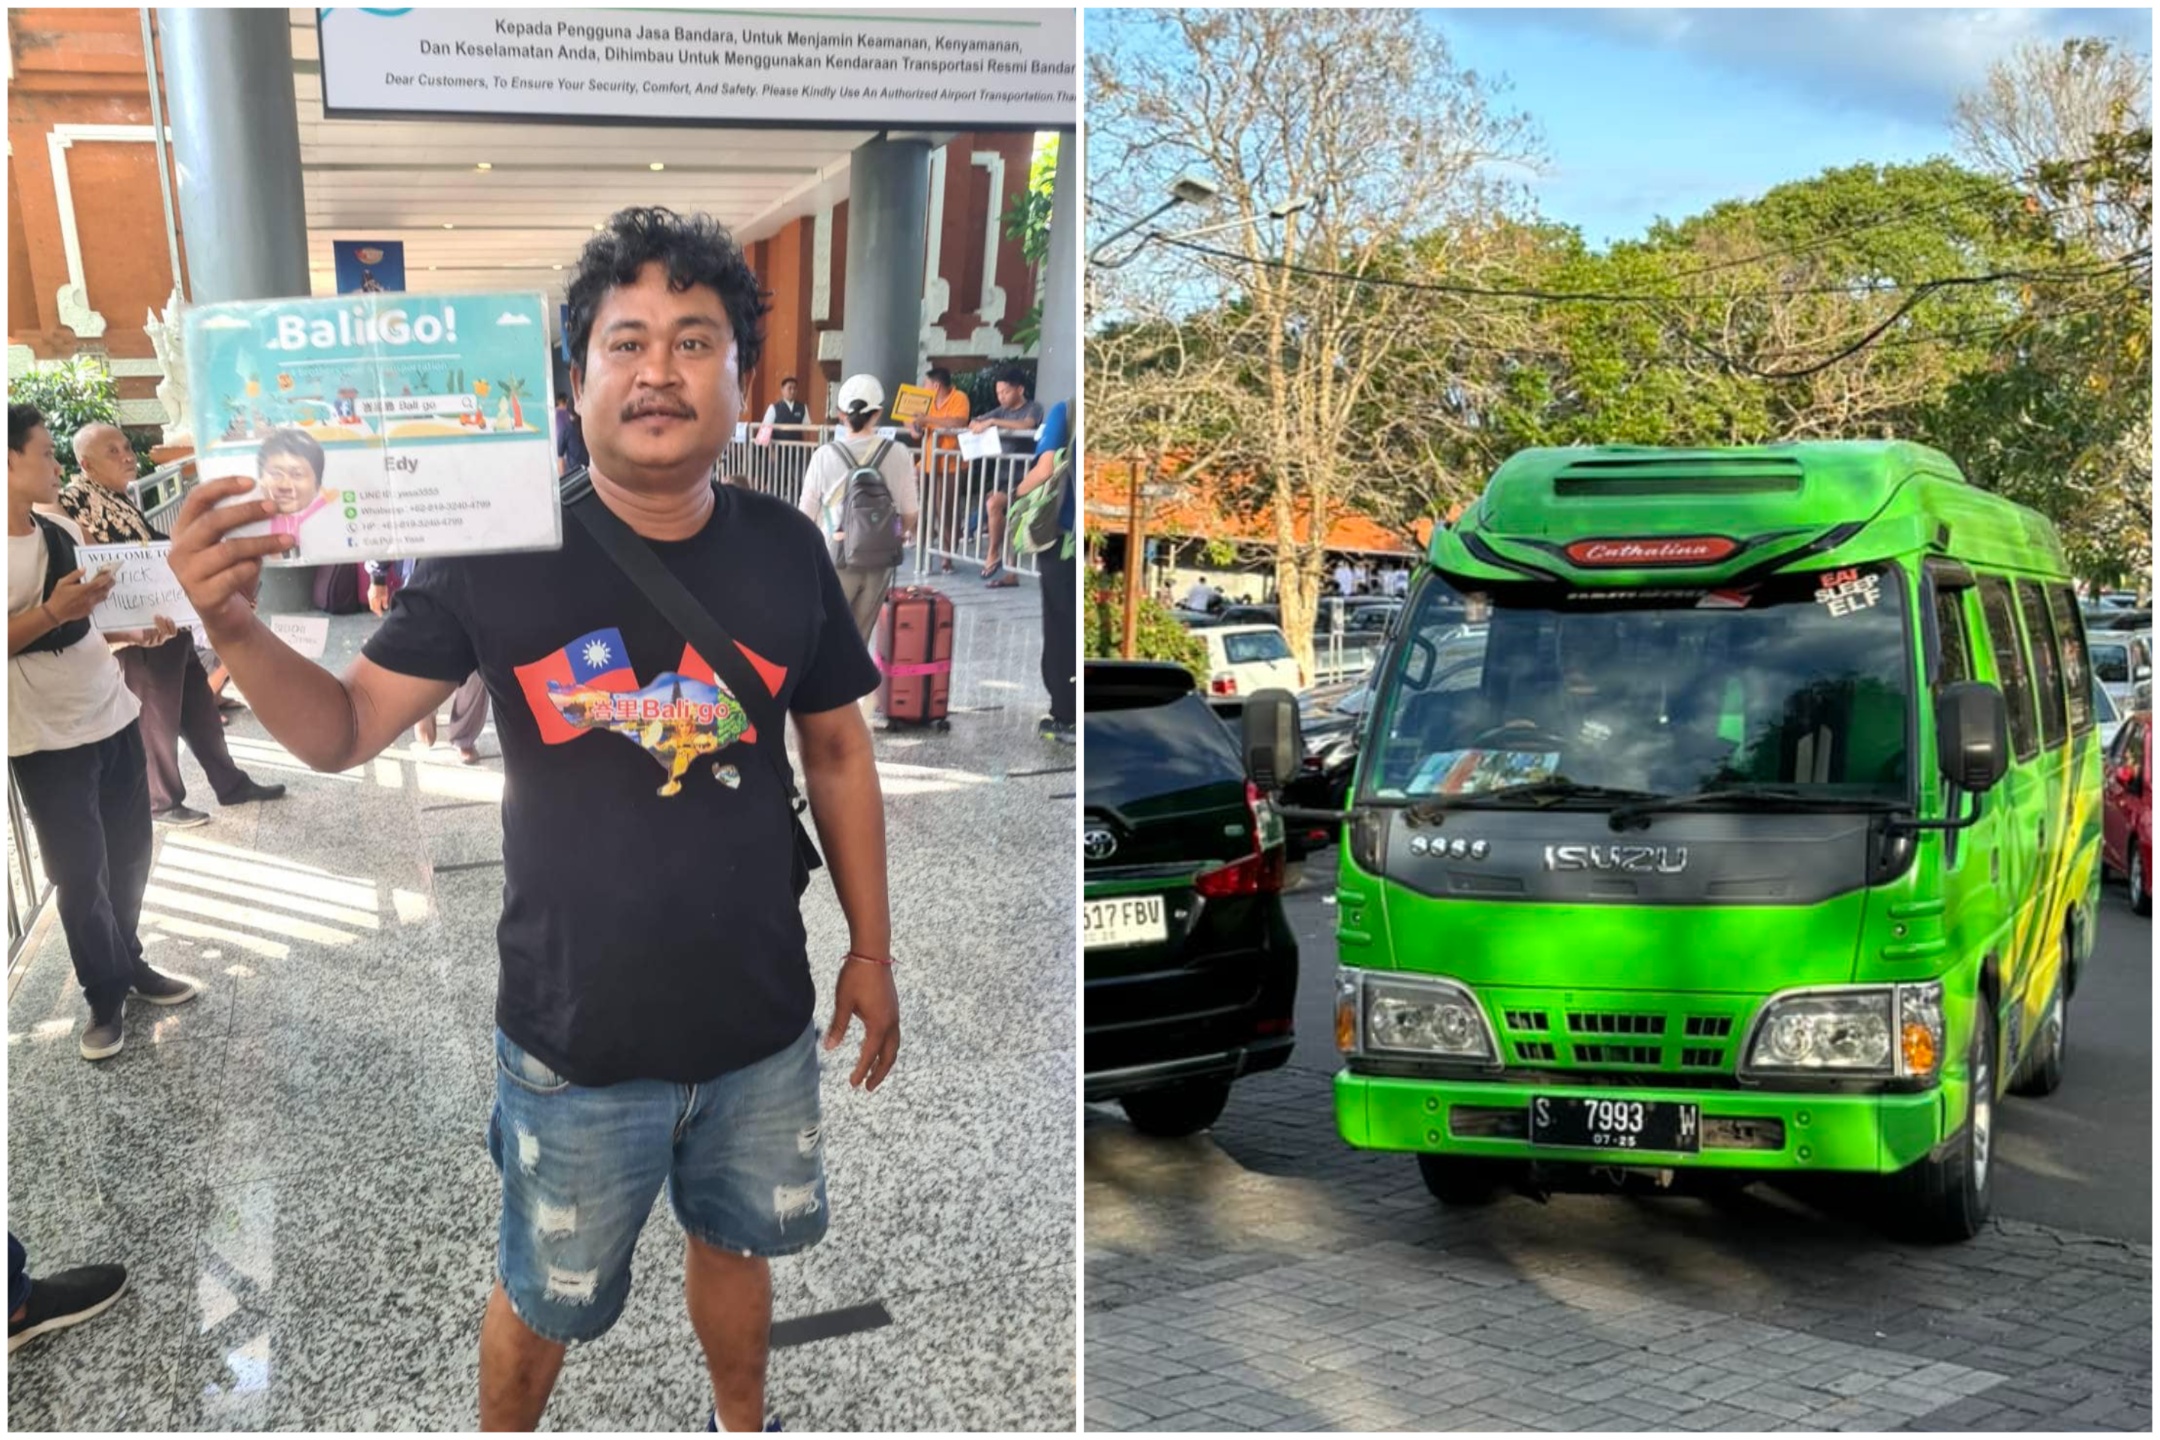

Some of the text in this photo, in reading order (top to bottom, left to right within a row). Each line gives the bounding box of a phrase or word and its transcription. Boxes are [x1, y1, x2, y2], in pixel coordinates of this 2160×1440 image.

[495, 19, 1023, 54] Kepada Pengguna Jasa Bandara, Untuk Menjamin Keamanan, Kenyamanan,
[419, 40, 451, 55] Dan
[455, 40, 554, 59] Keselamatan
[557, 45, 601, 62] Anda,
[604, 46, 674, 64] Dihimbau
[678, 49, 720, 65] Untuk
[724, 51, 821, 70] Menggunakan
[825, 54, 898, 71] Kendaraan
[902, 56, 984, 74] Transportasi
[987, 58, 1027, 74] Resmi
[384, 72, 415, 86] Dear
[418, 73, 489, 90] Customers,
[493, 76, 508, 88] To
[511, 76, 554, 90] Ensure
[557, 78, 585, 91] Your
[588, 79, 639, 95] Security,
[642, 80, 692, 95] Comfort,
[695, 81, 718, 95] And
[721, 82, 759, 97] Safety.
[761, 84, 799, 98] Please
[802, 84, 837, 100] Kindly
[840, 86, 860, 99] Use
[862, 86, 878, 99] An
[879, 86, 938, 100] Authorized
[940, 88, 976, 102] Airport
[278, 305, 457, 350] Bali Go!
[385, 456, 418, 474] Edy
[360, 488, 380, 500] LINE
[88, 551, 152, 562] WELCOME
[1814, 573, 1879, 603] SLEEP
[1821, 567, 1858, 588] EAT
[1827, 588, 1881, 618] ELF
[641, 698, 690, 720] Bali
[698, 702, 731, 725] go
[1544, 845, 1688, 874] ISUZU
[1123, 900, 1159, 925] FBV
[1535, 1097, 1697, 1137] S 7993 W
